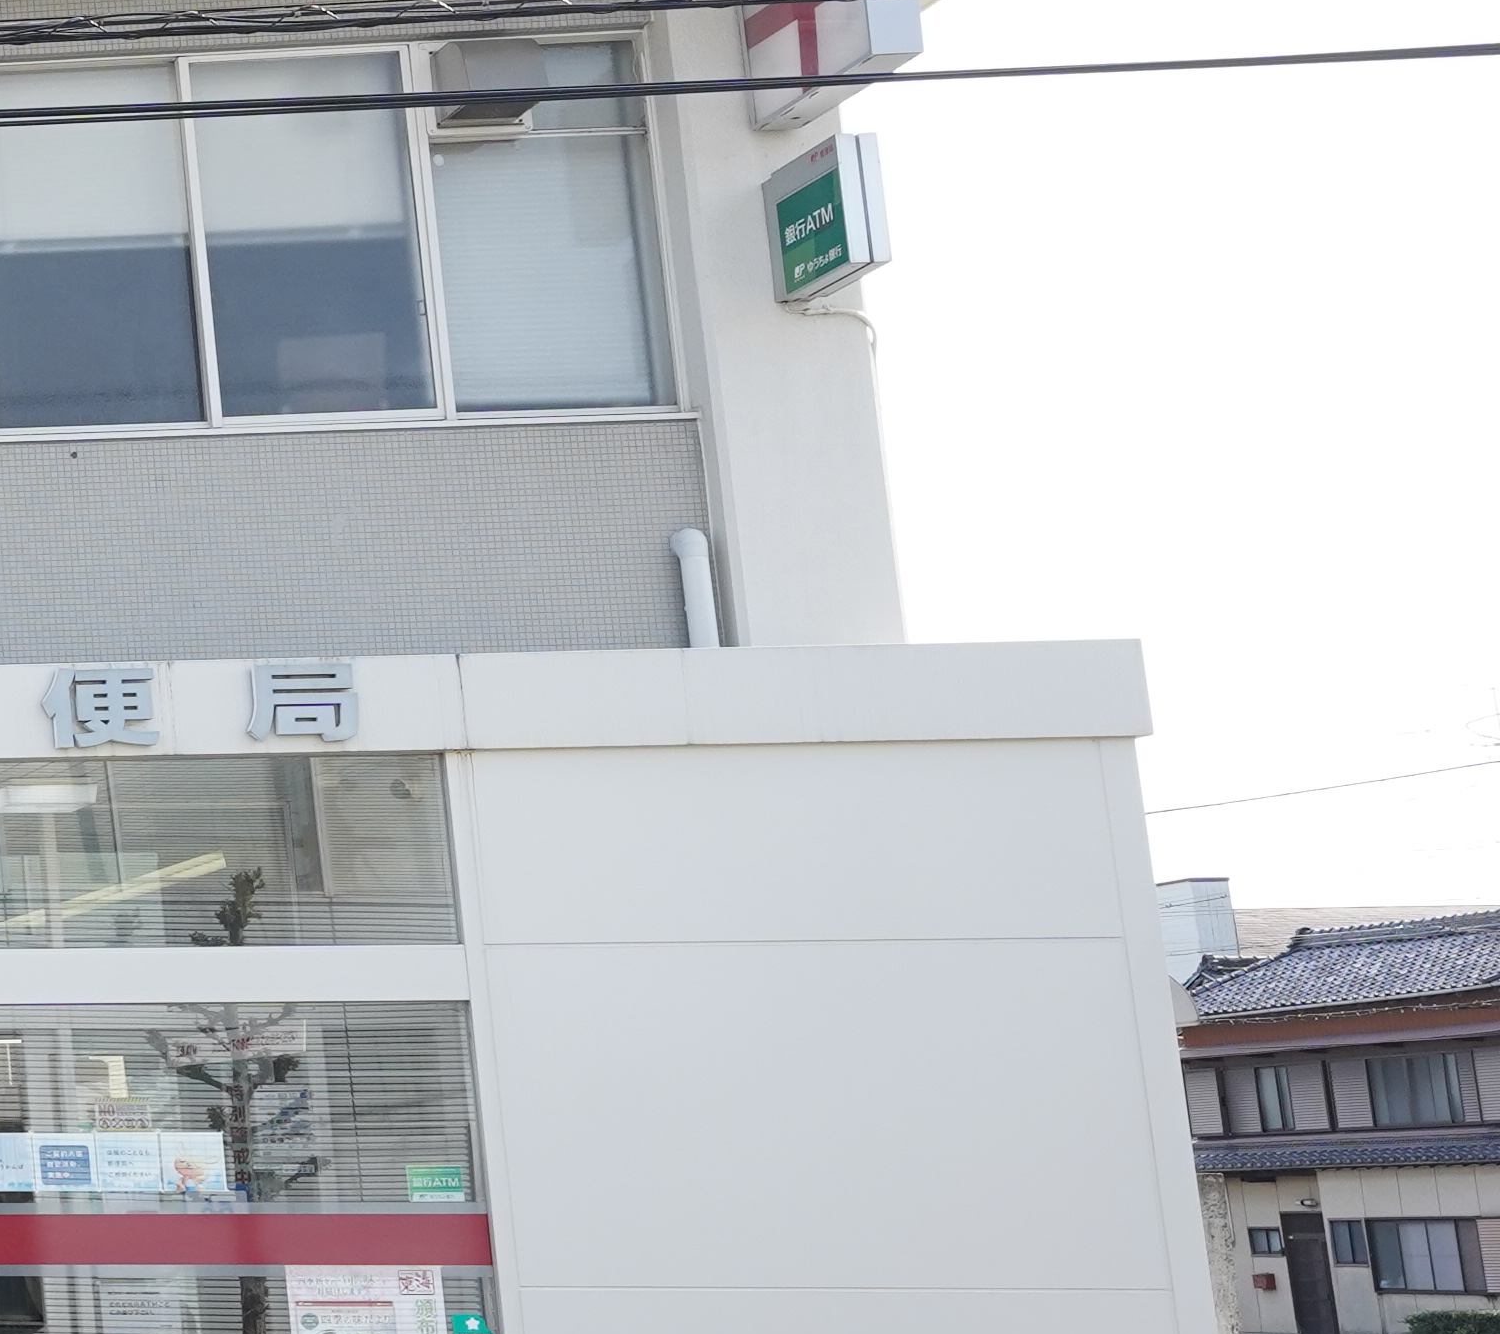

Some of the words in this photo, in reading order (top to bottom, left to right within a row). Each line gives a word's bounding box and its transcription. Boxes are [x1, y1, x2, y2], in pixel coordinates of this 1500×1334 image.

[784, 203, 834, 246] 銀行ATM
[807, 244, 842, 272] ゆうちょ銀行
[412, 1177, 460, 1187] 銀行ATM
